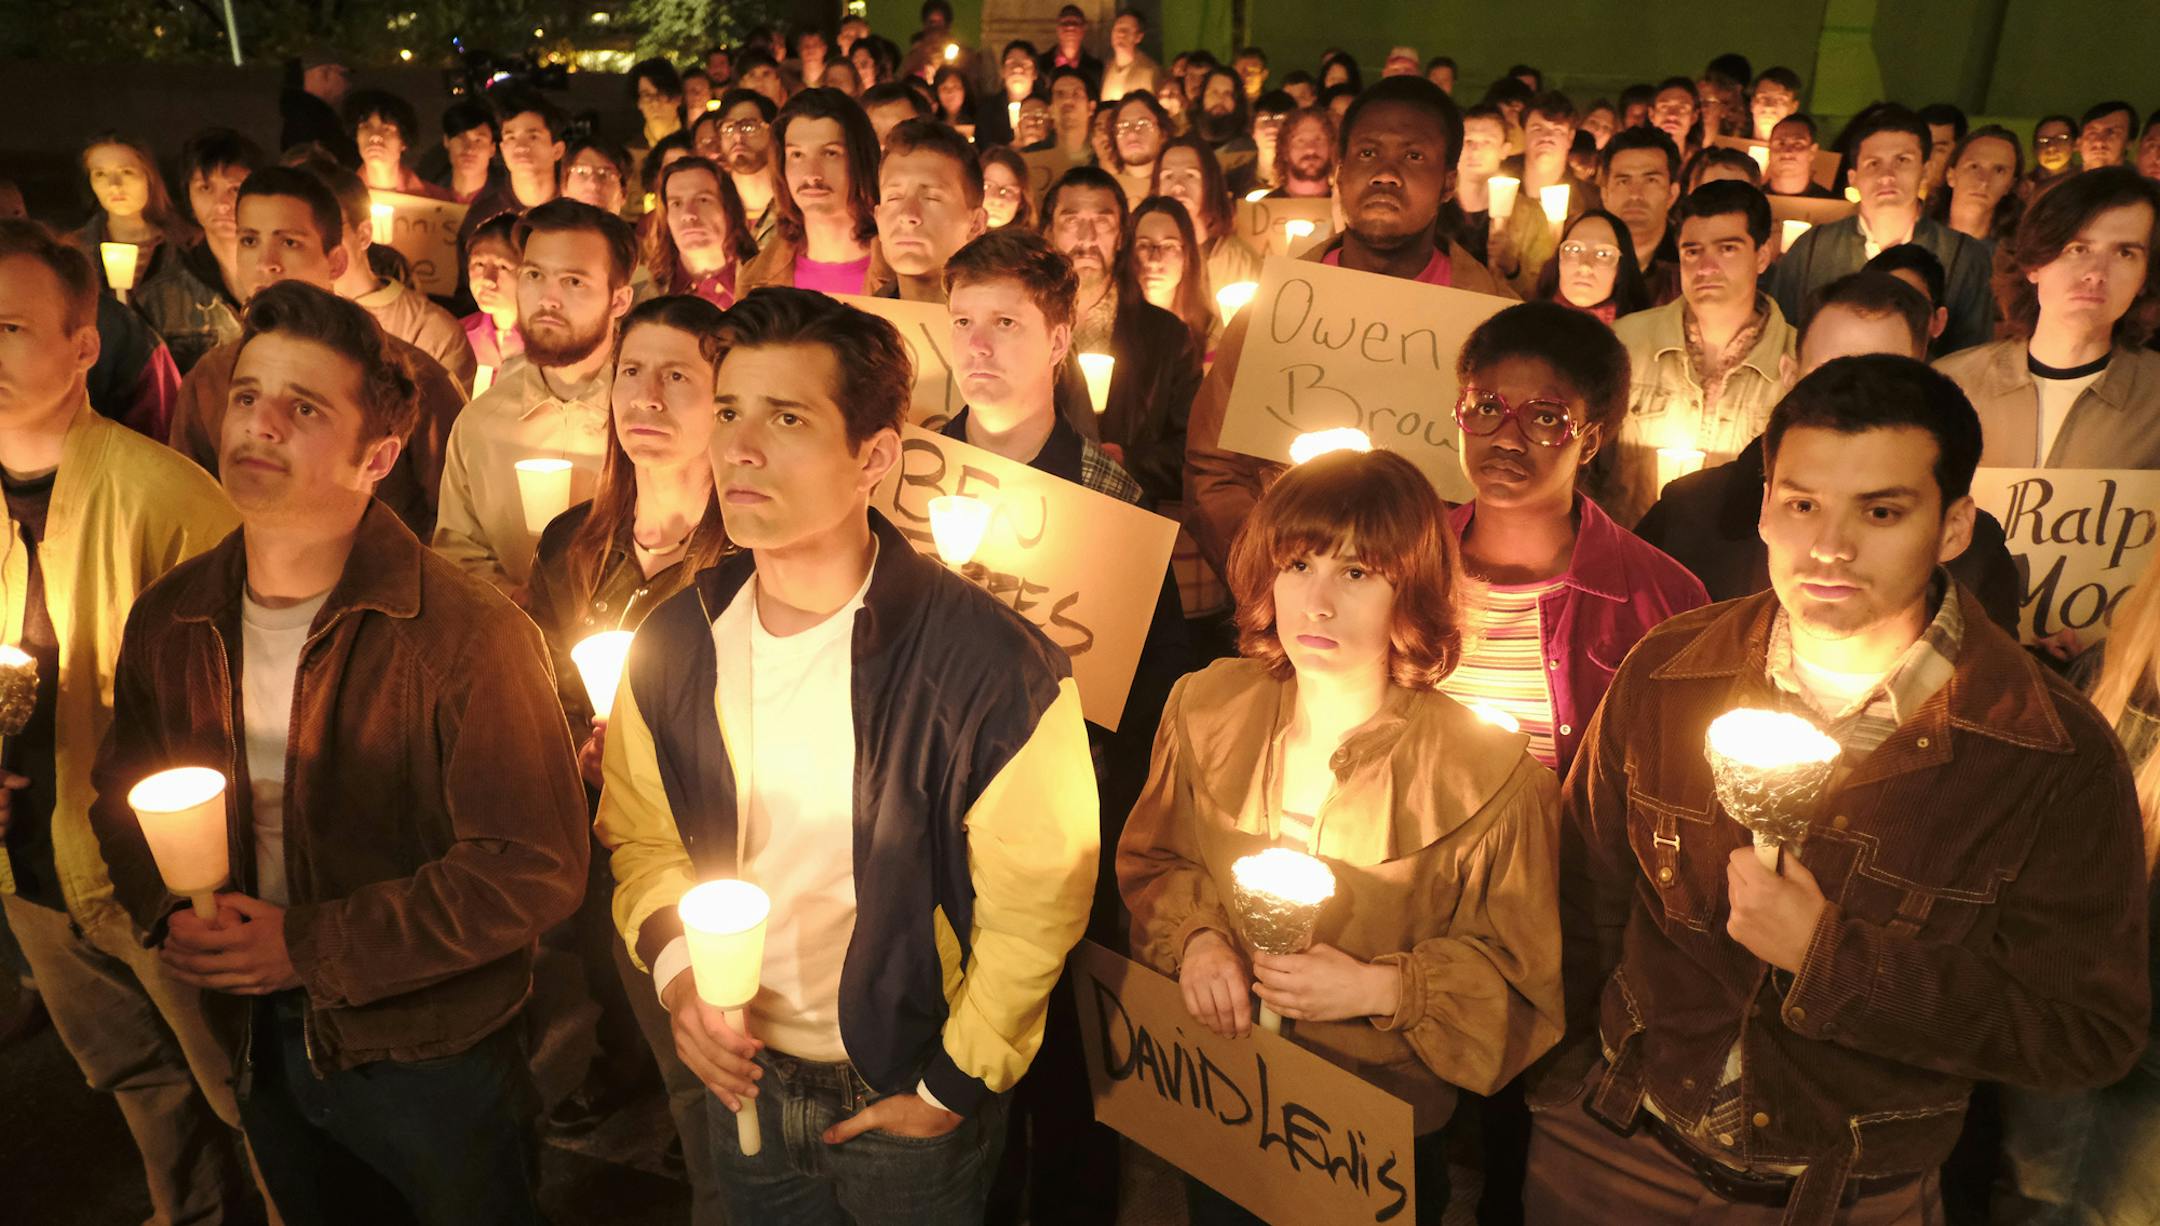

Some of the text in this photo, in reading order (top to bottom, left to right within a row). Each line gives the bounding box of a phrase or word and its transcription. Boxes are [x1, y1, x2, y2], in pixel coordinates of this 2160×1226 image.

[394, 206, 458, 246] nnis
[1271, 279, 1440, 370] Owen
[1266, 363, 1461, 452] Brow
[2004, 478, 2157, 571] Ralp
